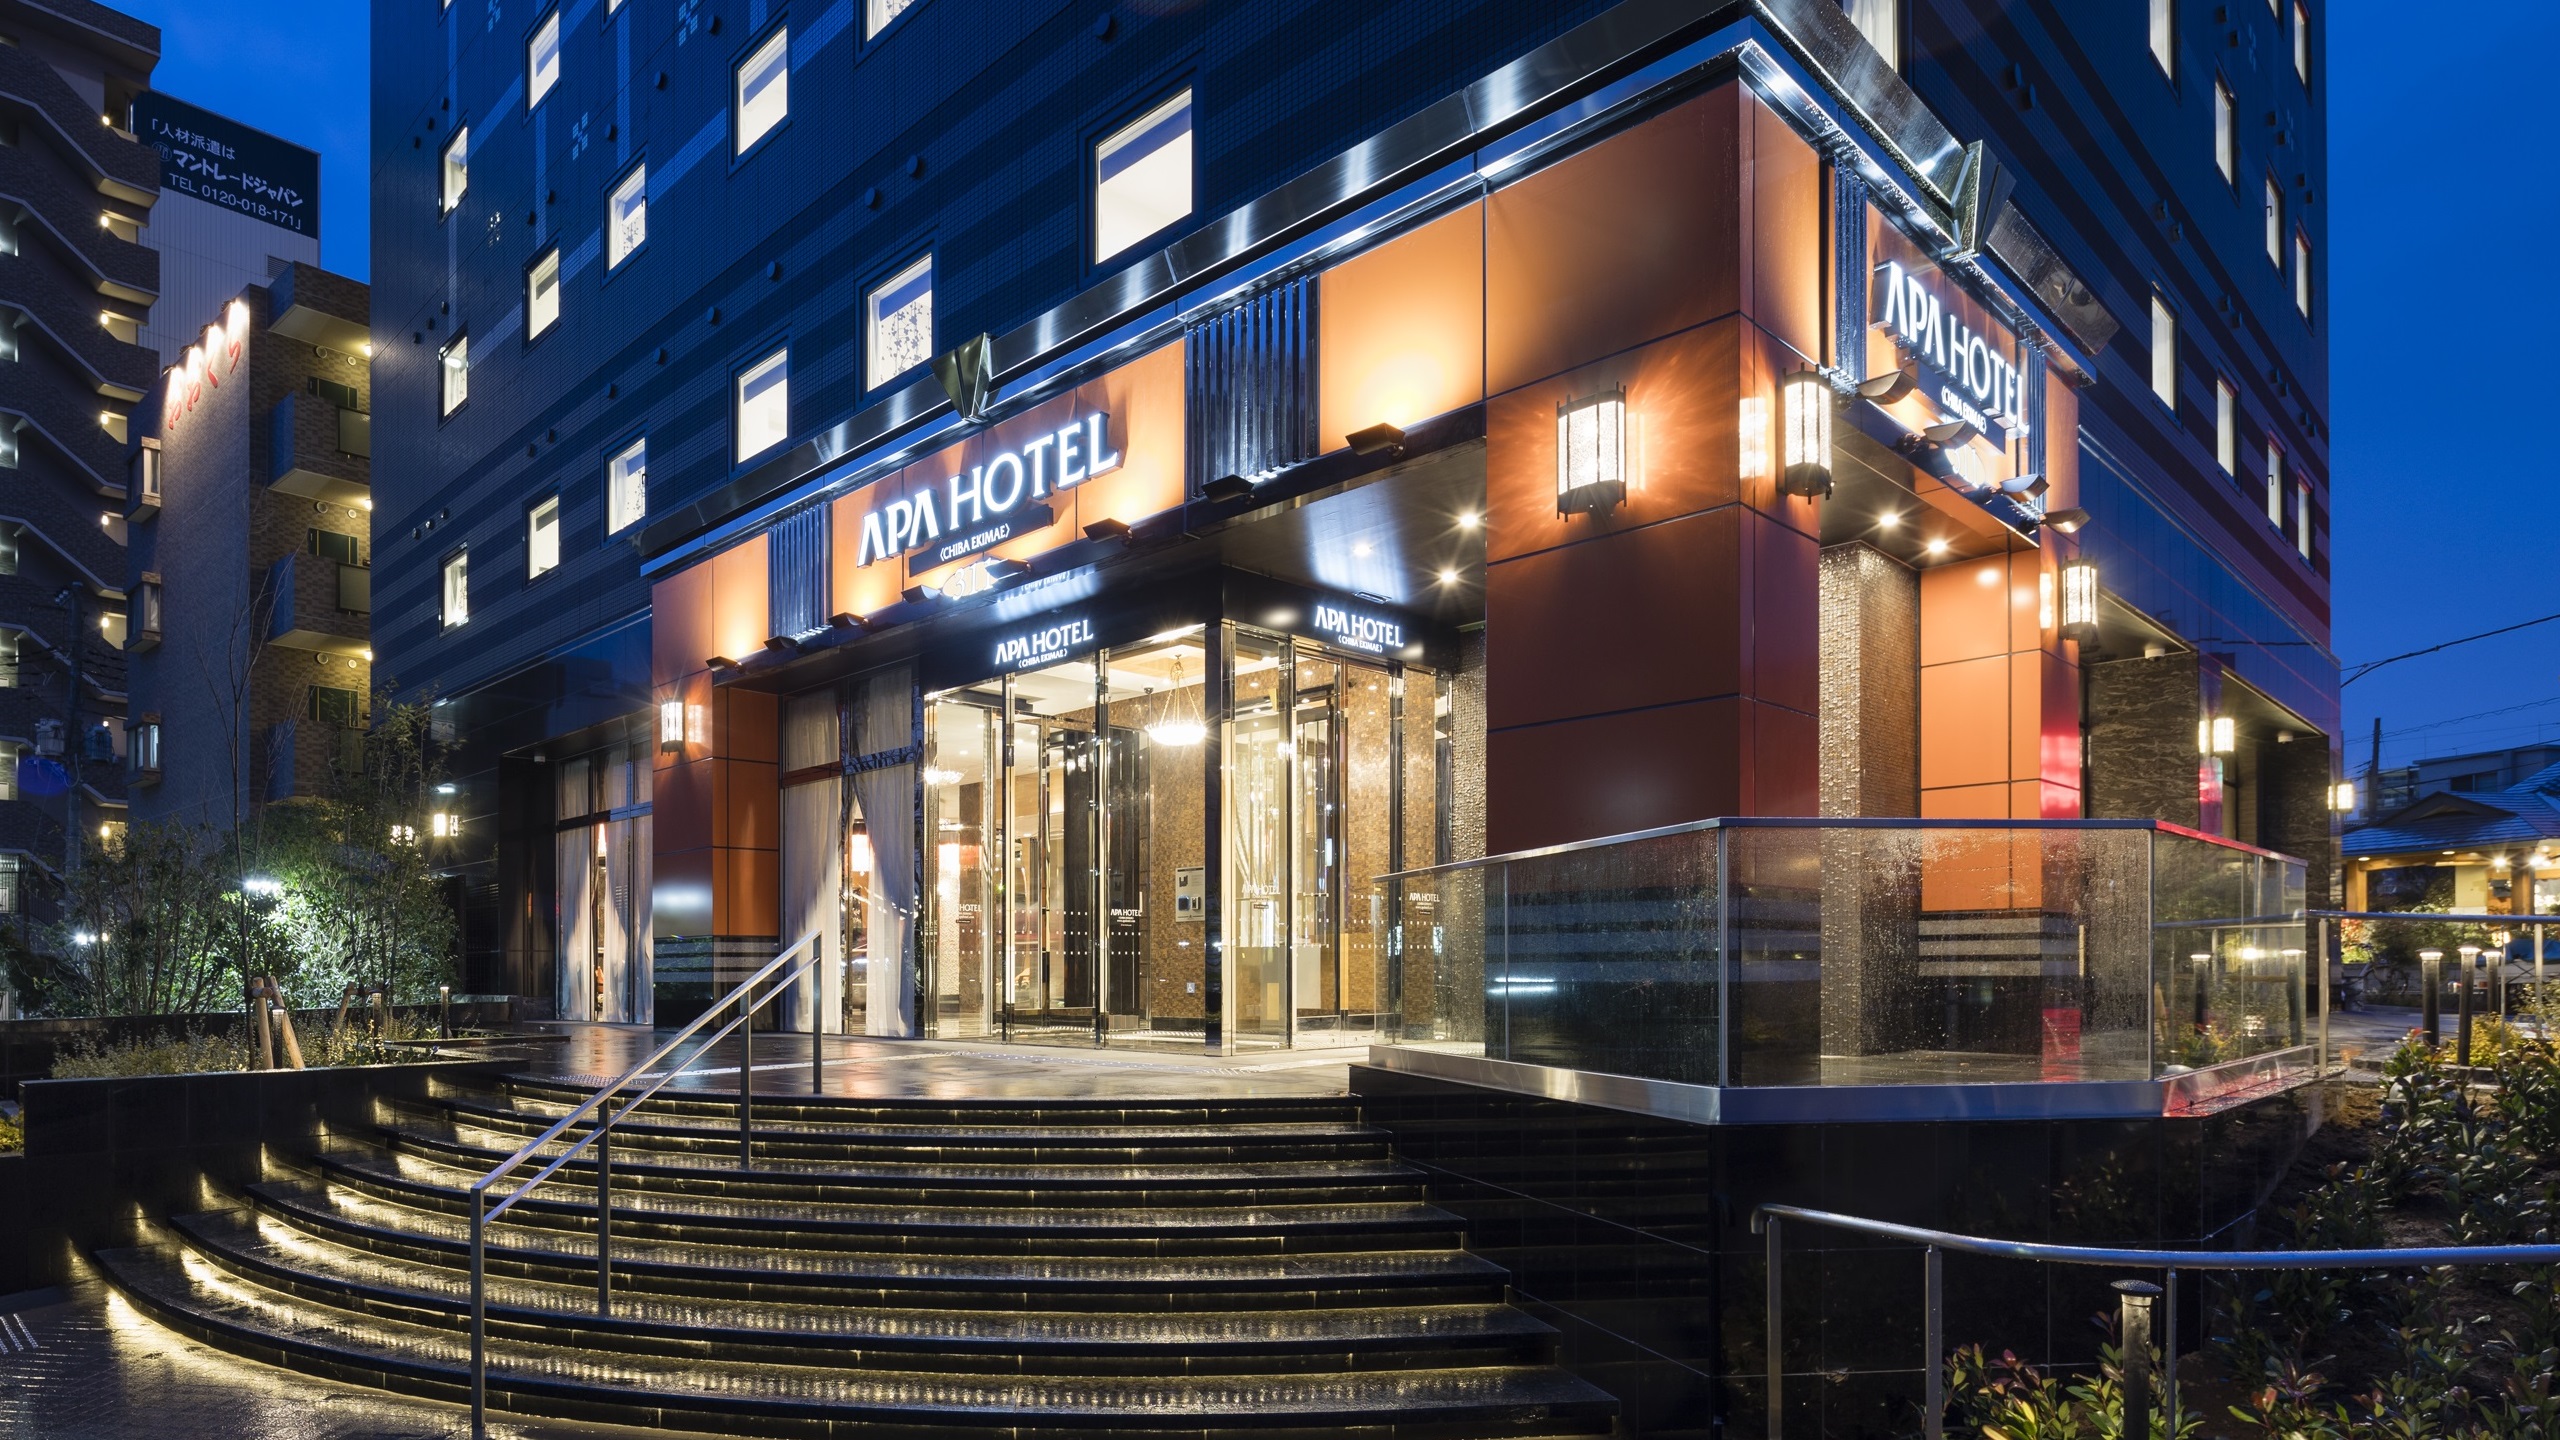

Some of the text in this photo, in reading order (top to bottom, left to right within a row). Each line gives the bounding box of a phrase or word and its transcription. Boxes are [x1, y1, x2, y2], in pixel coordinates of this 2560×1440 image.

[169, 173, 197, 193] TEL
[173, 149, 303, 207] マントレードジャパン
[1885, 261, 2030, 435] APA HOTEL
[857, 411, 1118, 567] APA HOTEL
[995, 620, 1093, 665] APA HOTEL
[1315, 606, 1404, 648] APA HOTEL
[960, 903, 982, 912] HOTEL
[1110, 908, 1141, 917] APA HOTEL
[1409, 892, 1440, 902] APA HOTEL
